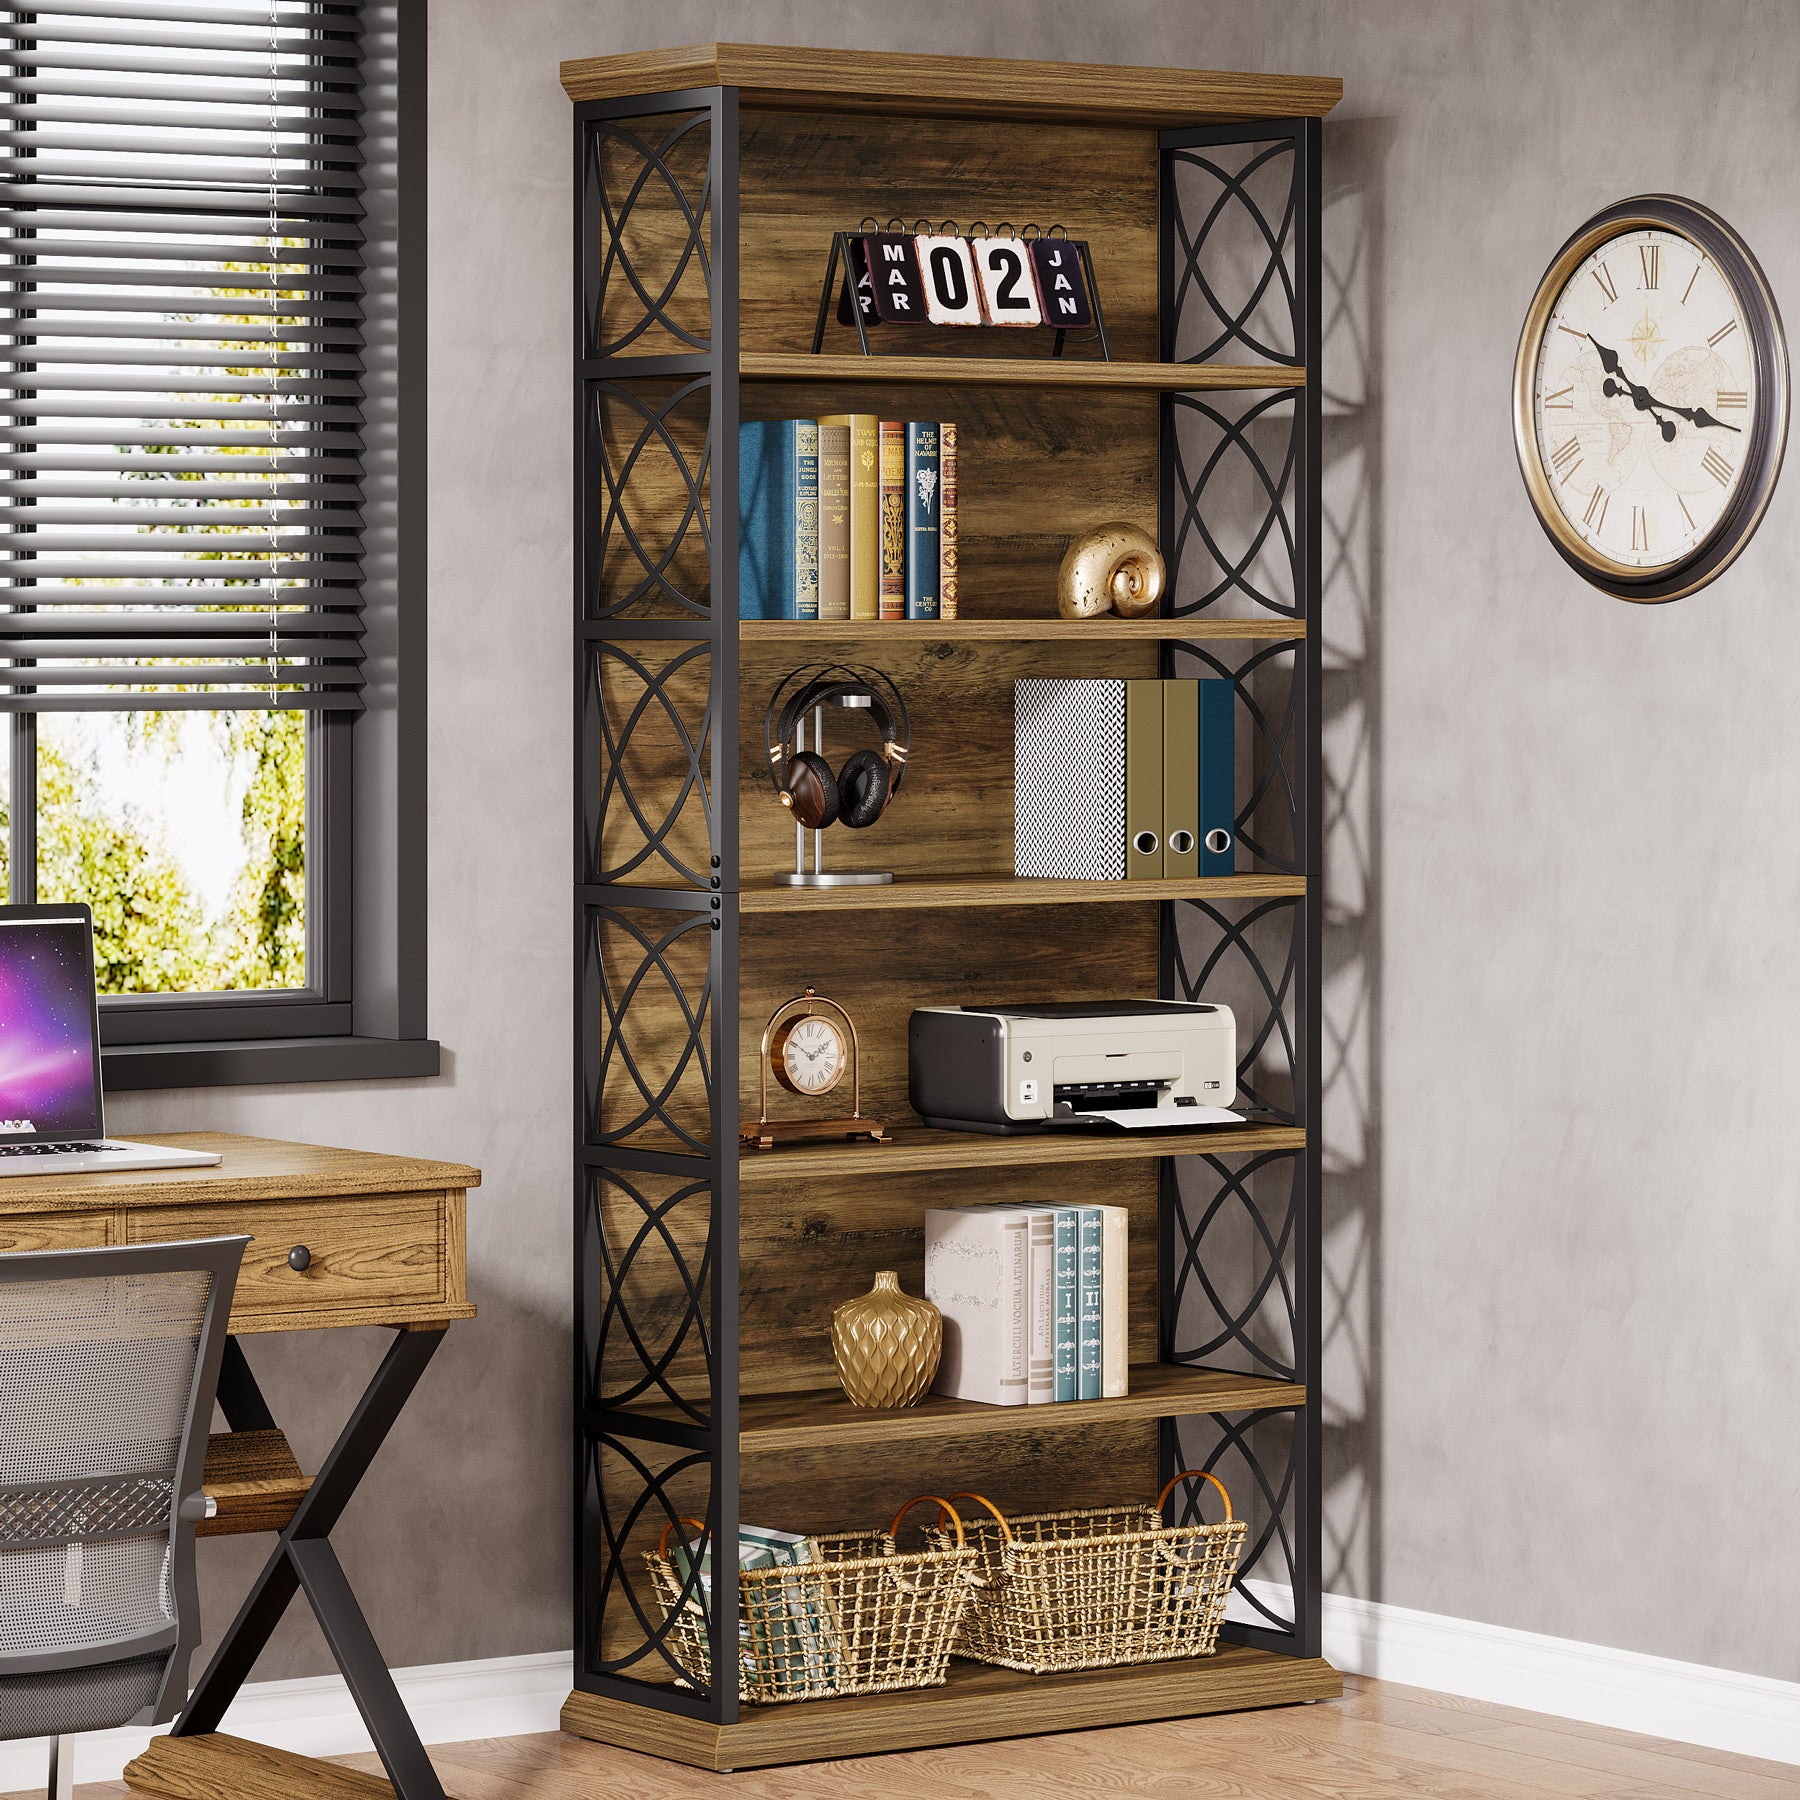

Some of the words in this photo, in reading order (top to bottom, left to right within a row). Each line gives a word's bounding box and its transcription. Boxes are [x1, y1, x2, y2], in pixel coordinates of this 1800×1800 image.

[882, 244, 911, 310] MAR
[1048, 250, 1078, 314] JAN
[1637, 246, 1661, 290] XII
[1706, 318, 1738, 351] II
[1716, 390, 1749, 412] III
[1632, 505, 1650, 552] VI
[1014, 1231, 1023, 1286] LATINARUM
[1013, 1288, 1022, 1324] VOCUM
[1065, 1293, 1072, 1309] I
[1085, 1291, 1099, 1307] II
[1038, 1325, 1045, 1337] AD
[1012, 1326, 1021, 1378] LATERCULI
